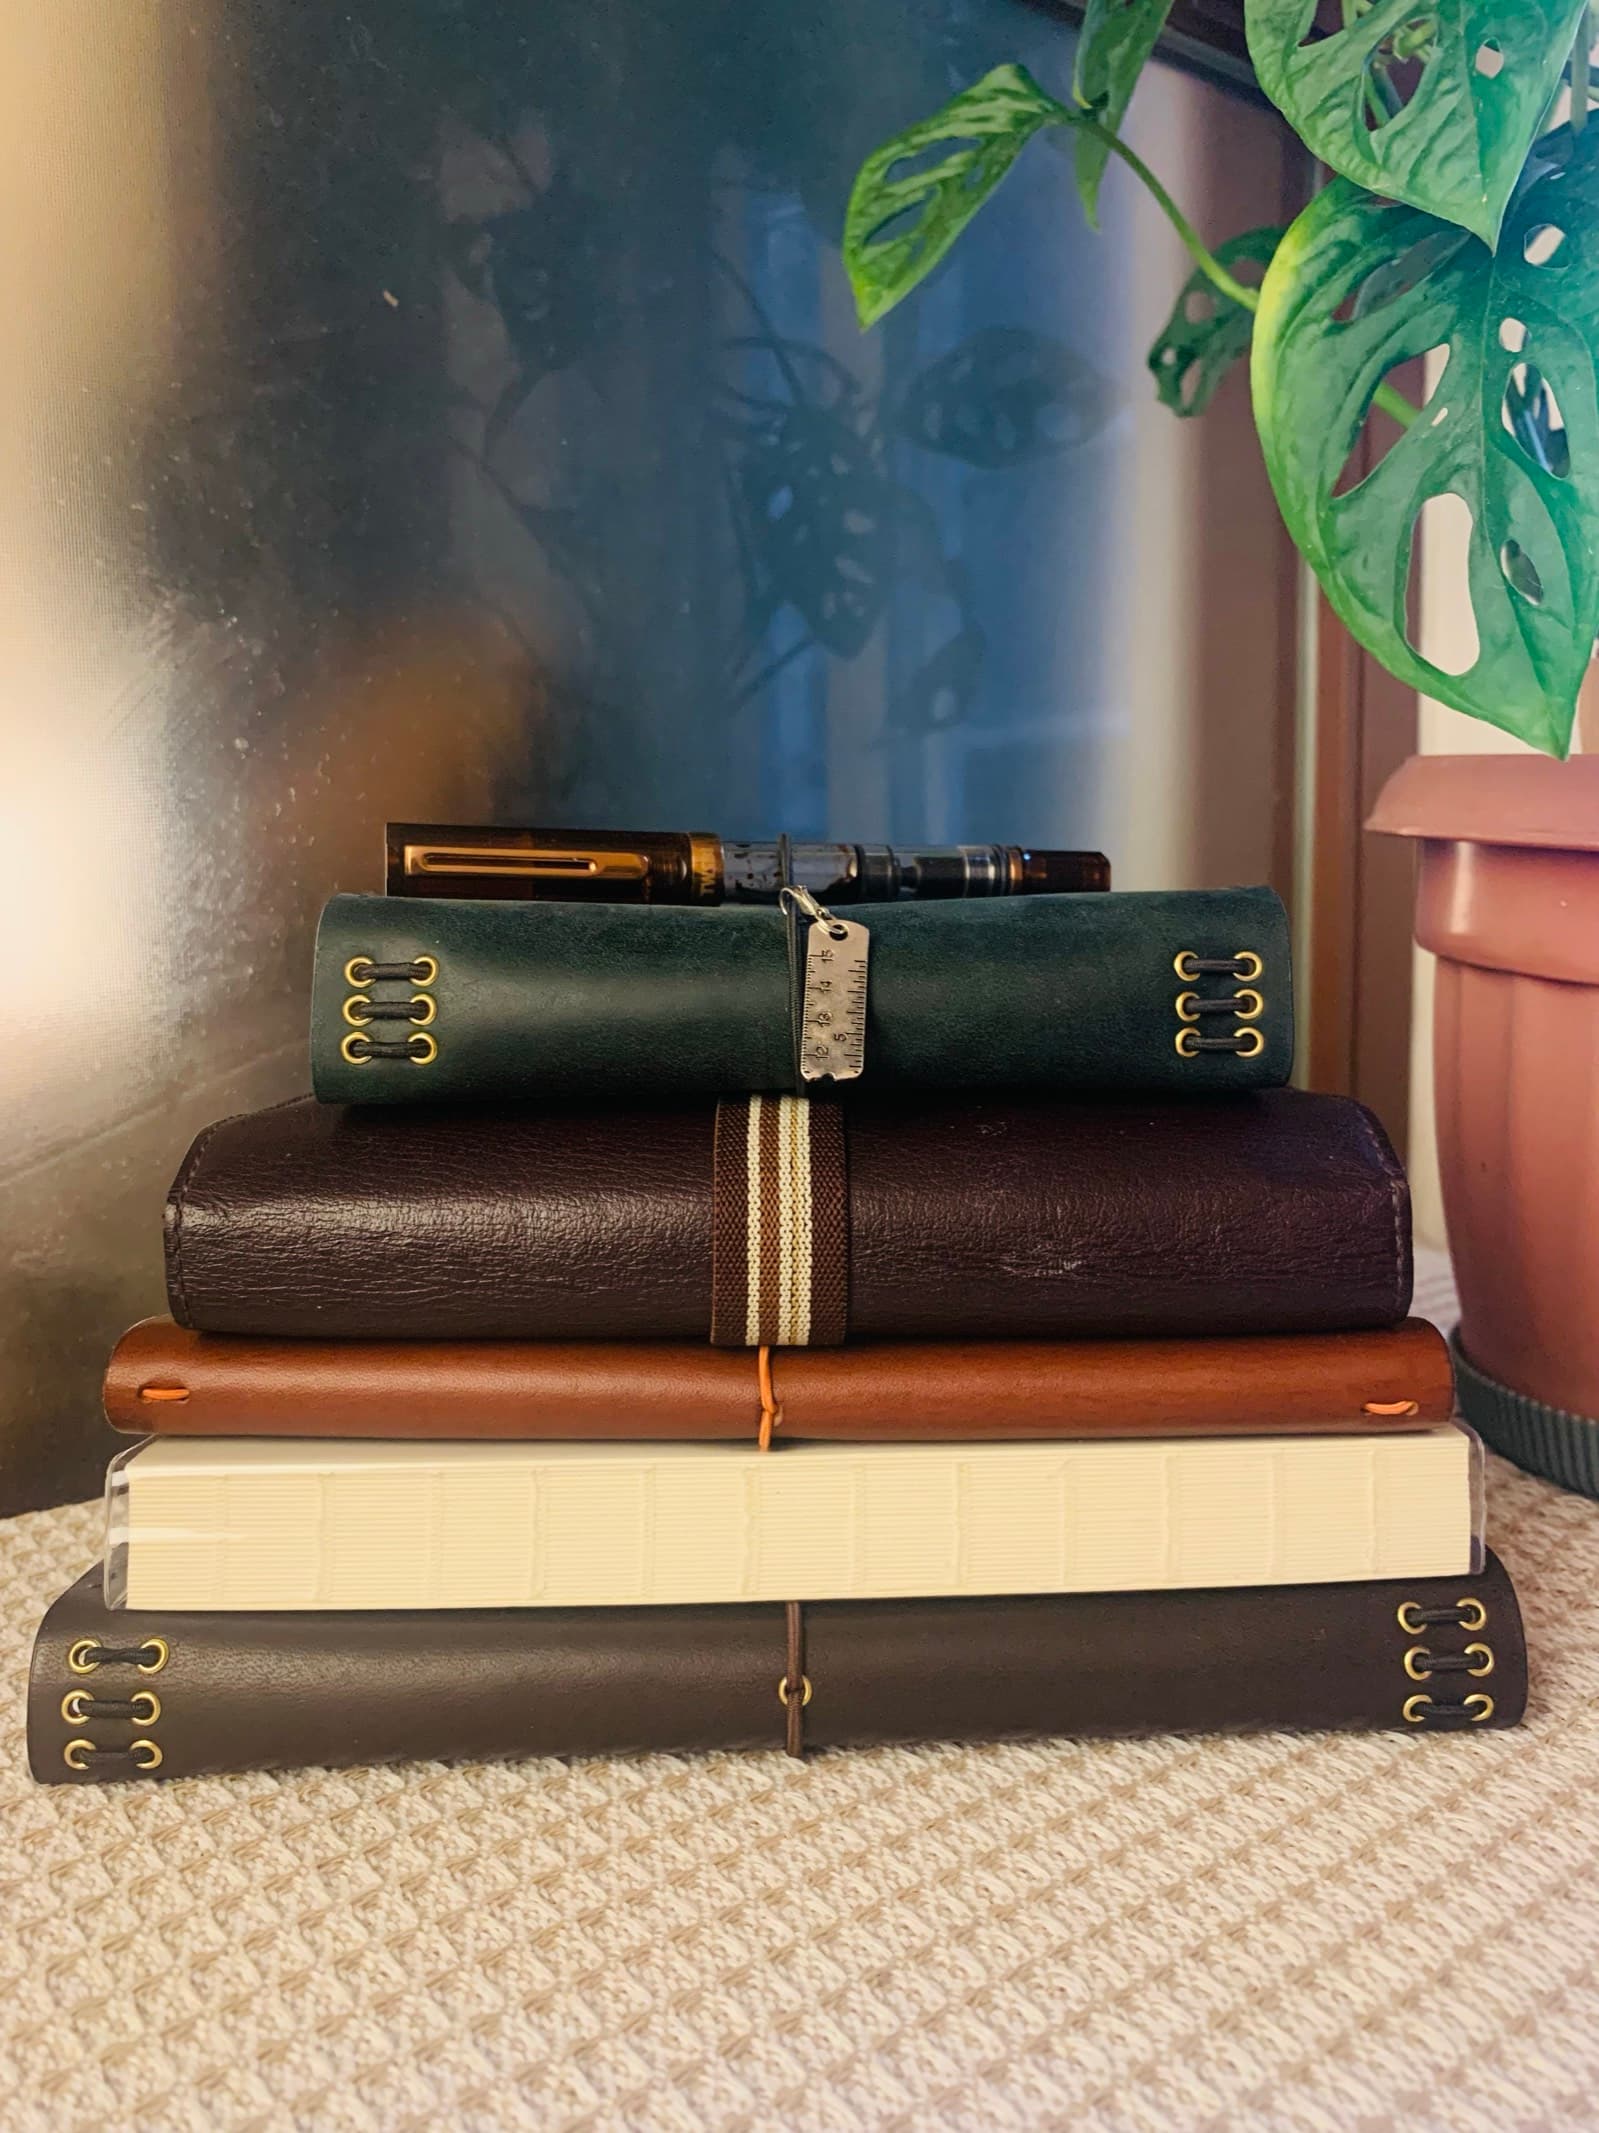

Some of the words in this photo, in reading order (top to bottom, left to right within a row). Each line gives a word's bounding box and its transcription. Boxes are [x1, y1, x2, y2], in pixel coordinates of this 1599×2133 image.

[820, 980, 833, 993] 14
[833, 1032, 848, 1042] 5
[815, 1045, 829, 1059] 12
